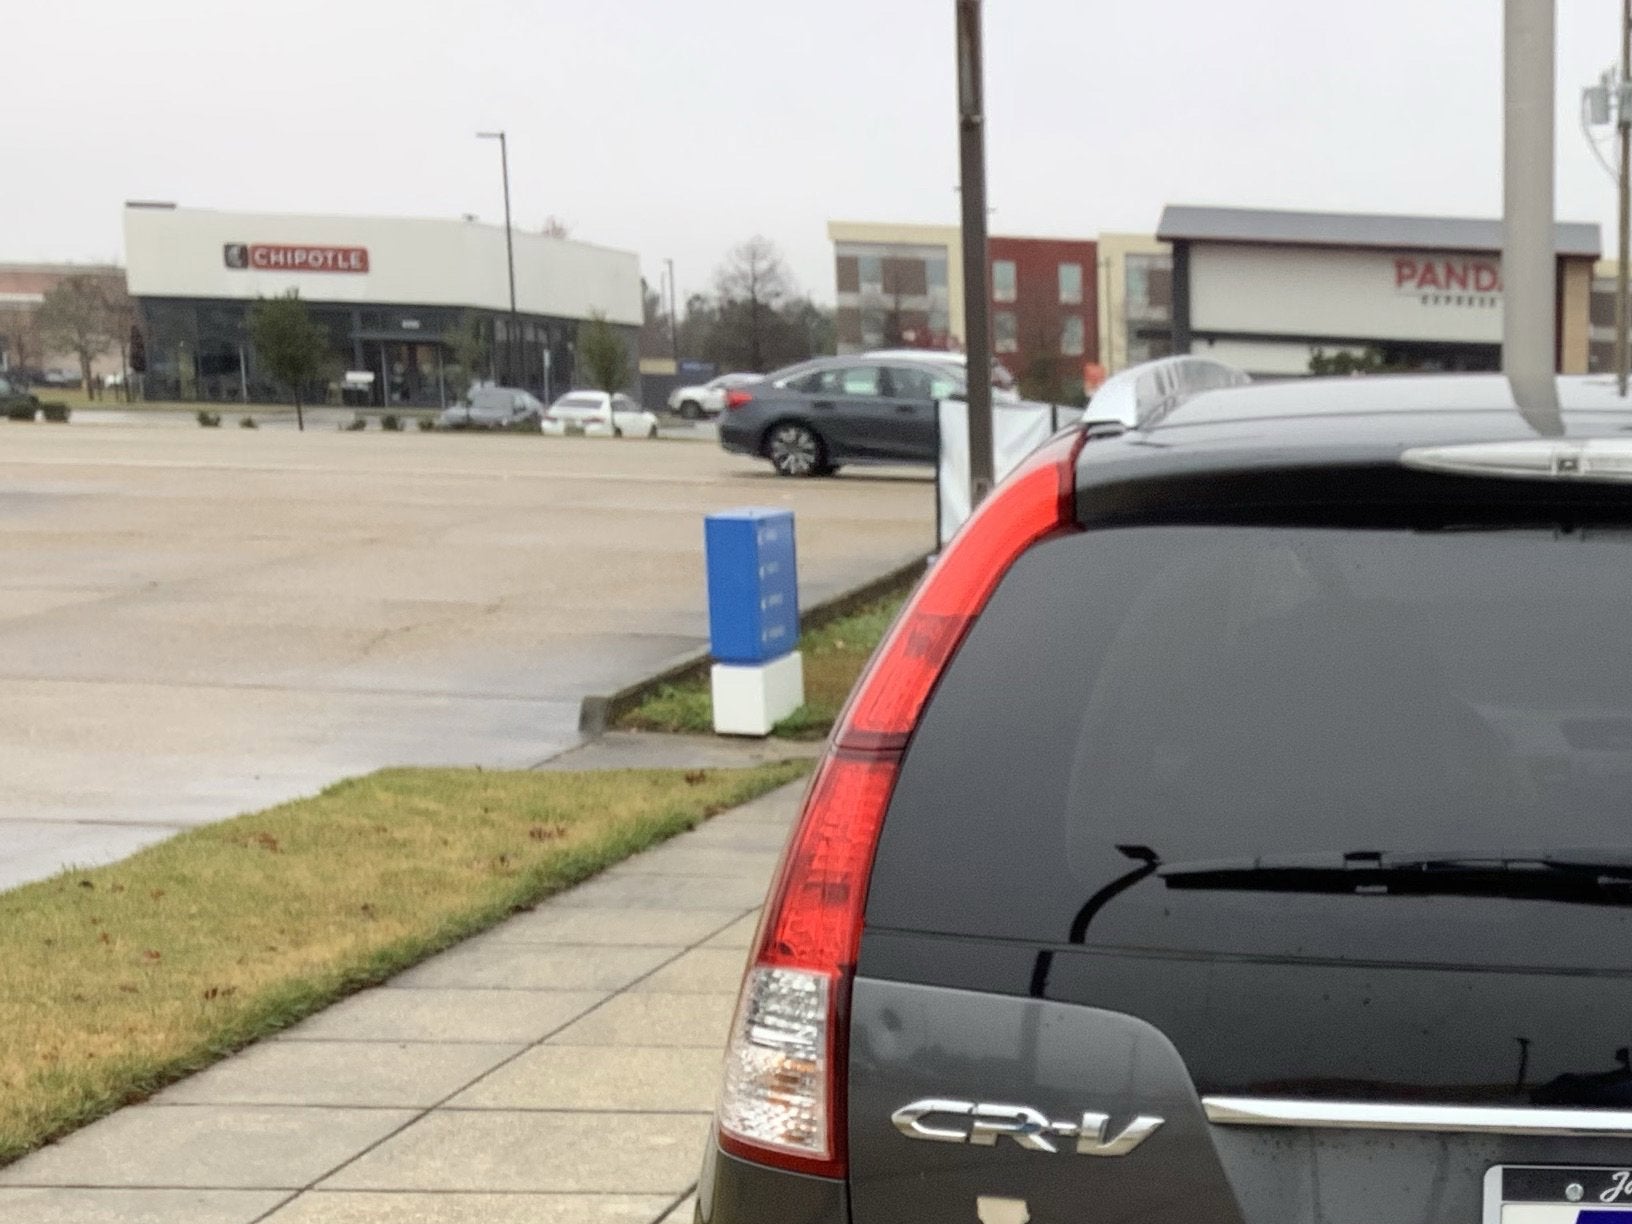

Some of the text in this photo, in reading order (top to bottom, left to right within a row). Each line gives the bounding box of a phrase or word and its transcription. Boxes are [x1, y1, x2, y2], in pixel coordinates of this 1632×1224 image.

[253, 248, 362, 270] CHIPOTLE
[1393, 257, 1502, 292] PAND
[891, 1098, 1165, 1157] CR-V
